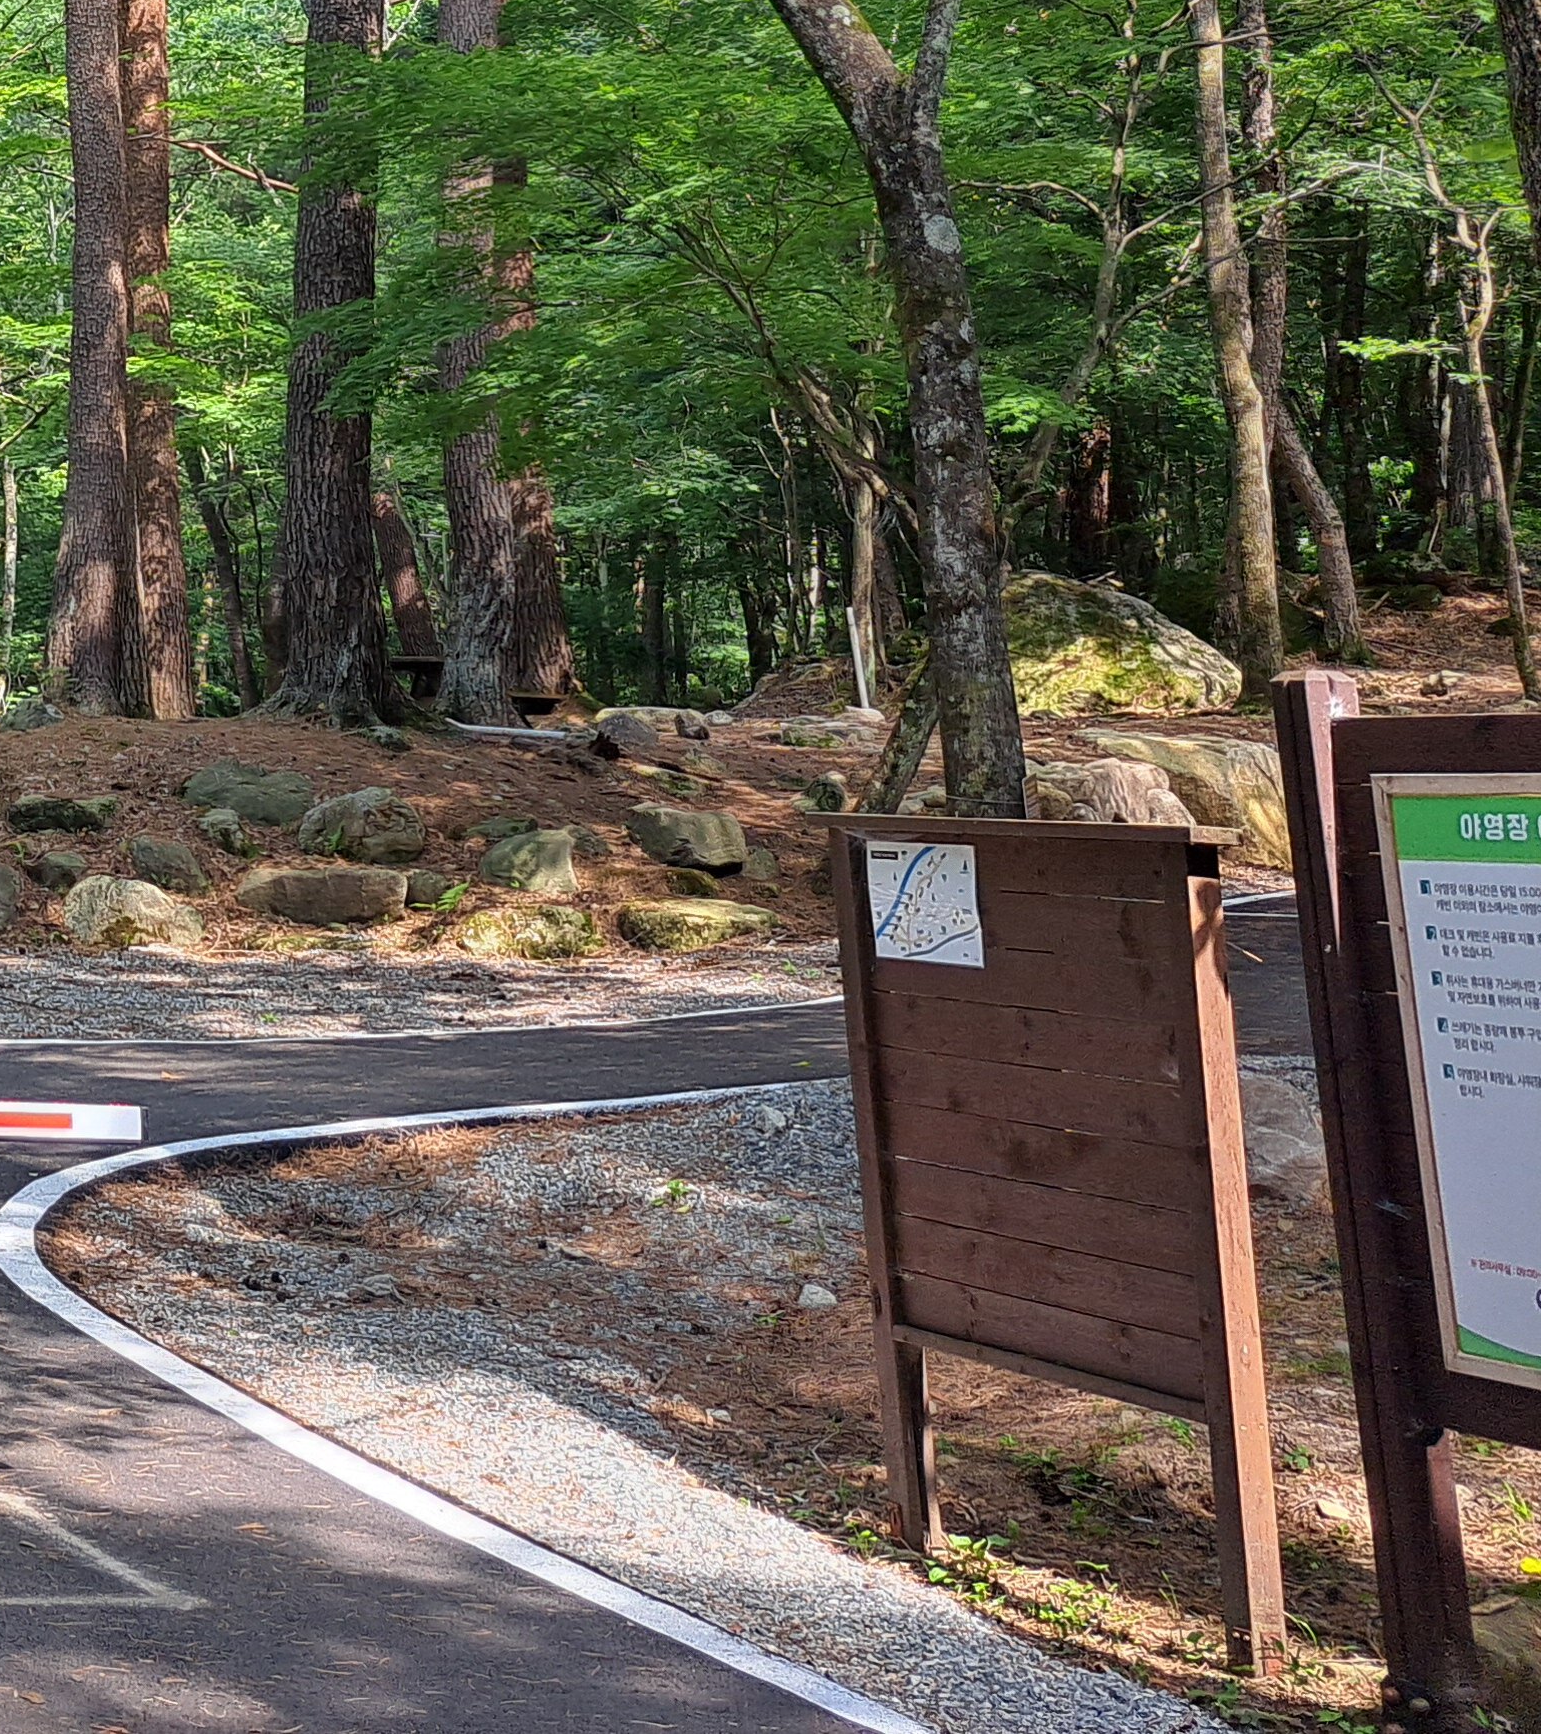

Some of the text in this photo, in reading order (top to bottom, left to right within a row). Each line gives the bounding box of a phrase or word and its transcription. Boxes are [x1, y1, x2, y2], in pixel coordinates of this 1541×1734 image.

[1460, 813, 1528, 841] 야영장
[1434, 883, 1457, 896] 야영장
[1458, 883, 1498, 897] 이용시간은
[1478, 901, 1519, 915] 장소에서는
[1439, 928, 1455, 940] 데크
[1457, 929, 1465, 942] 및
[1451, 946, 1459, 958] 수
[1461, 945, 1495, 959] 없습니다.
[1457, 991, 1496, 1007] 자연보호를
[1451, 1021, 1482, 1036] 쓰레기는
